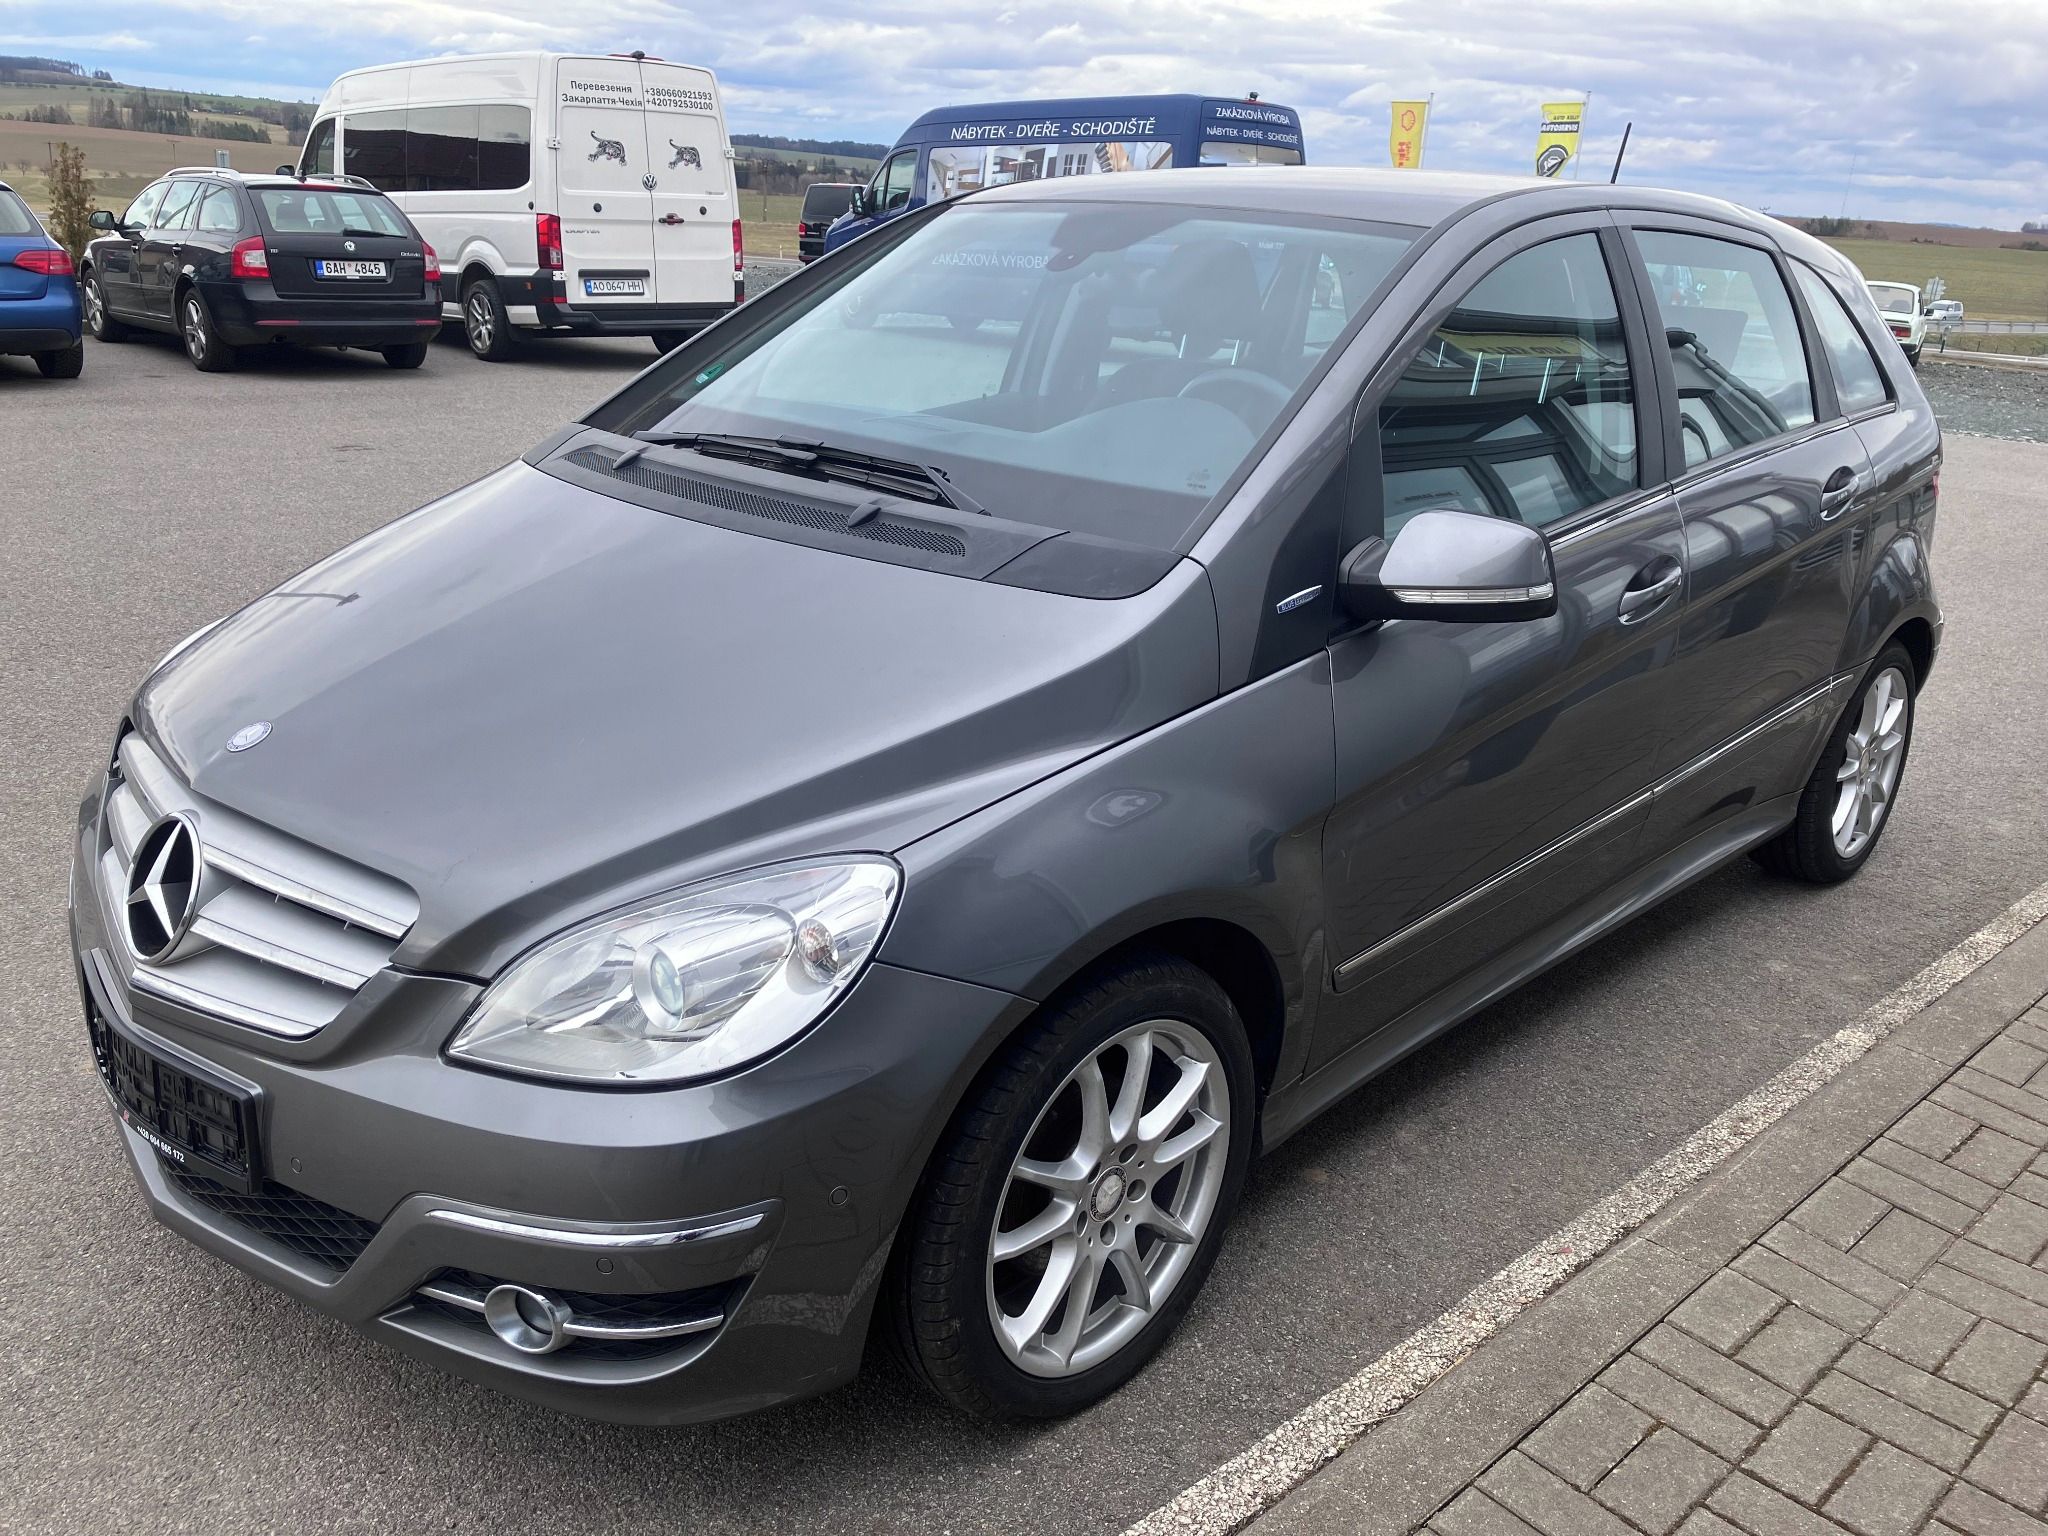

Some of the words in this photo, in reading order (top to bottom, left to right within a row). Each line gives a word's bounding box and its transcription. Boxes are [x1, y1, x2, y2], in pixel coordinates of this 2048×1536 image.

[570, 80, 632, 93] Перевезення
[561, 93, 643, 107] Закарпаття-Чехія
[645, 87, 712, 101] +380660921593
[645, 98, 713, 111] +420792530100
[1215, 106, 1264, 121] ZAKÁZKOVÁ
[1263, 110, 1291, 126] VÝROBA
[950, 124, 1008, 140] NÁBYTEK
[1016, 121, 1061, 138] DVEŘE
[1070, 117, 1156, 136] SCHODIŠTĚ
[1206, 126, 1239, 137] NÁBYTEK
[1243, 128, 1264, 140] DVEŘE
[325, 262, 347, 275] 6AH
[354, 263, 381, 275] 4845
[605, 281, 626, 291] 0647
[172, 1148, 185, 1163] 172
